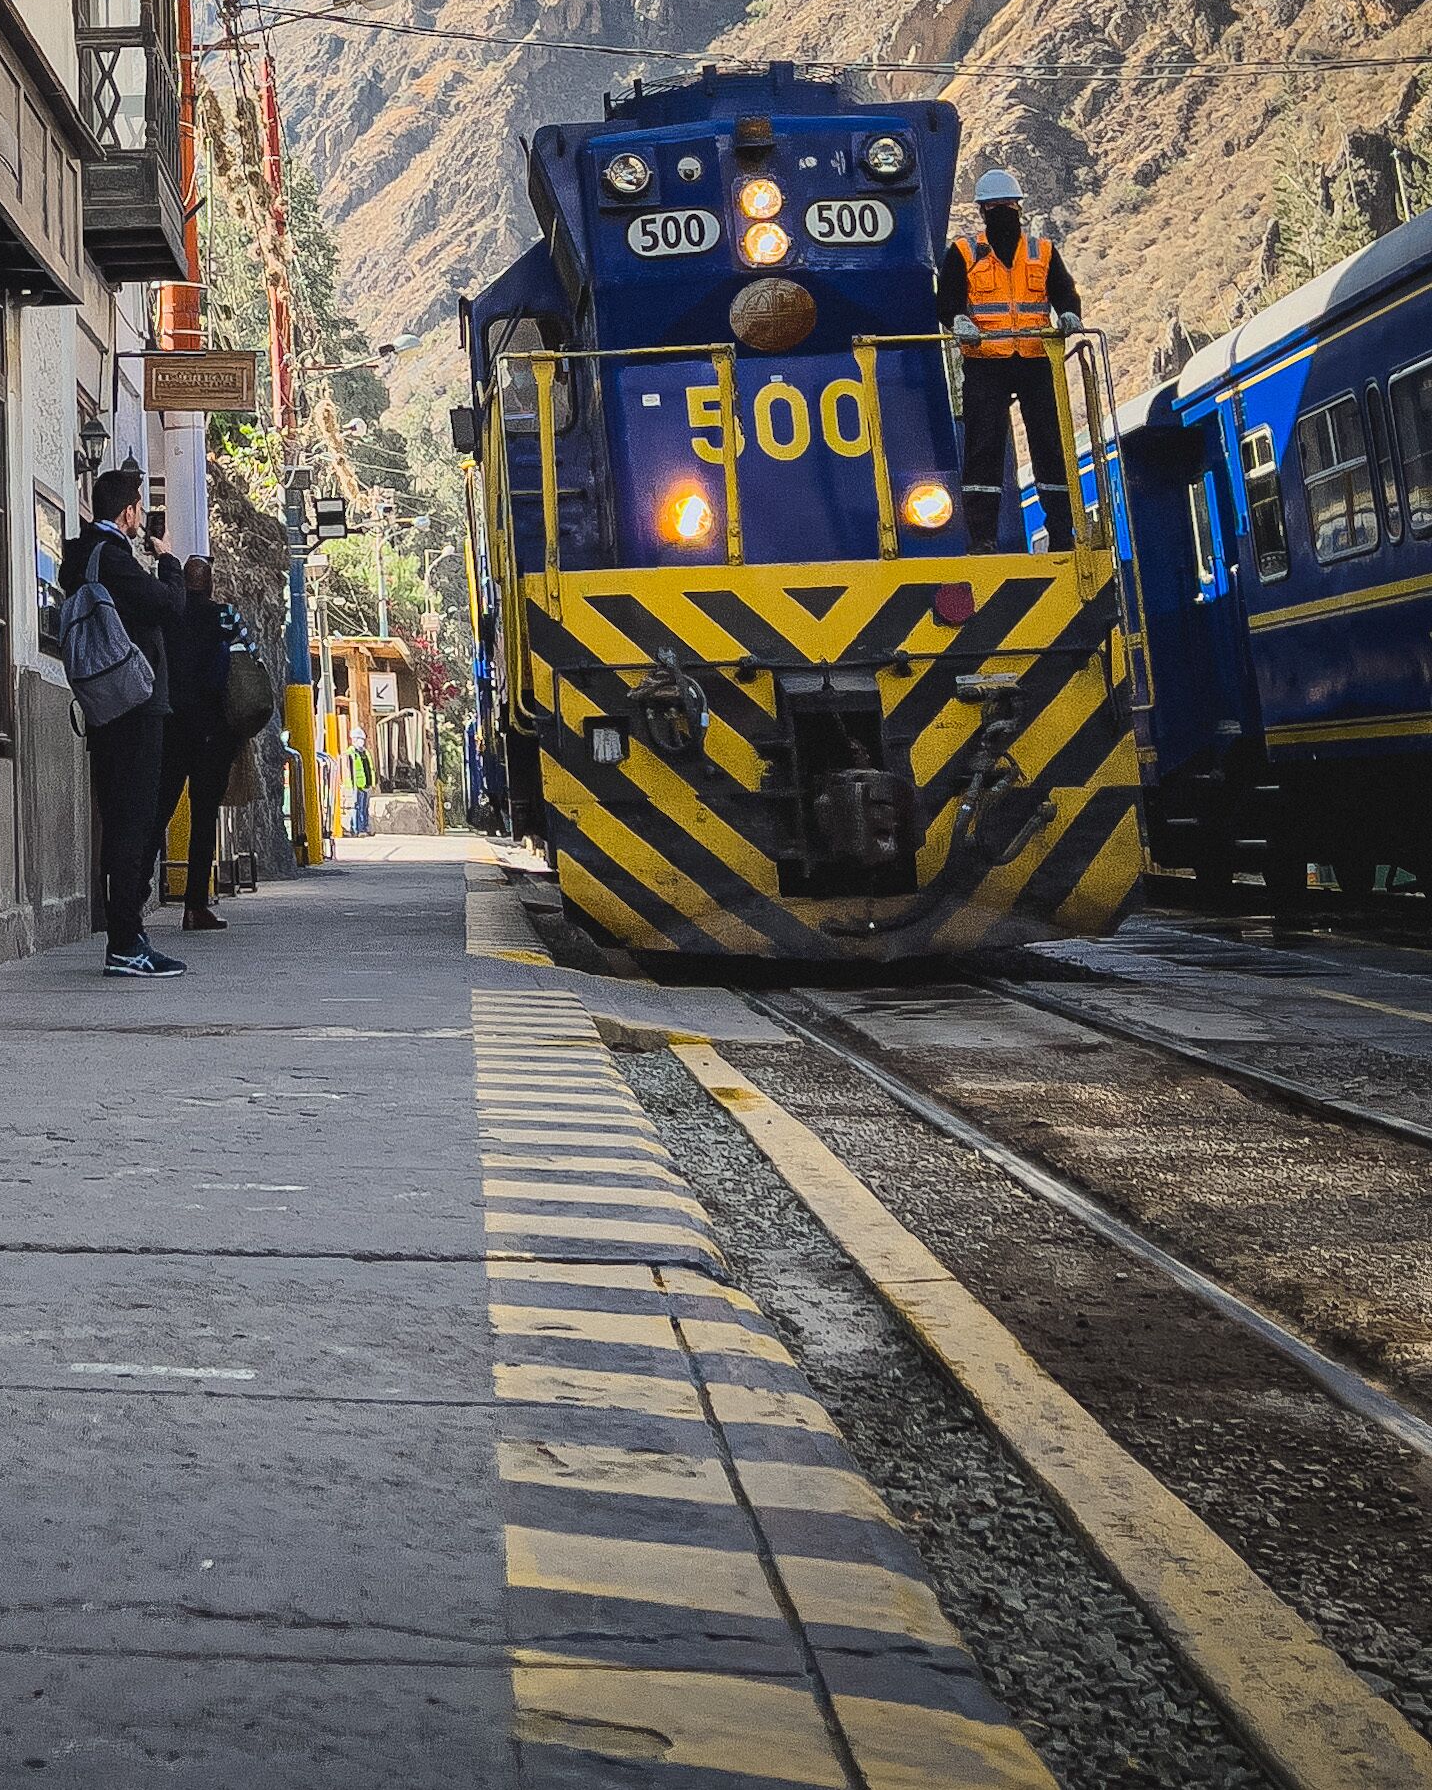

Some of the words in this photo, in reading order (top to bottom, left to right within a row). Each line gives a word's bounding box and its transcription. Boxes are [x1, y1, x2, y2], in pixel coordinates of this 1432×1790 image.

[640, 213, 706, 252] 500
[817, 204, 879, 238] 500
[685, 378, 873, 464] 500
